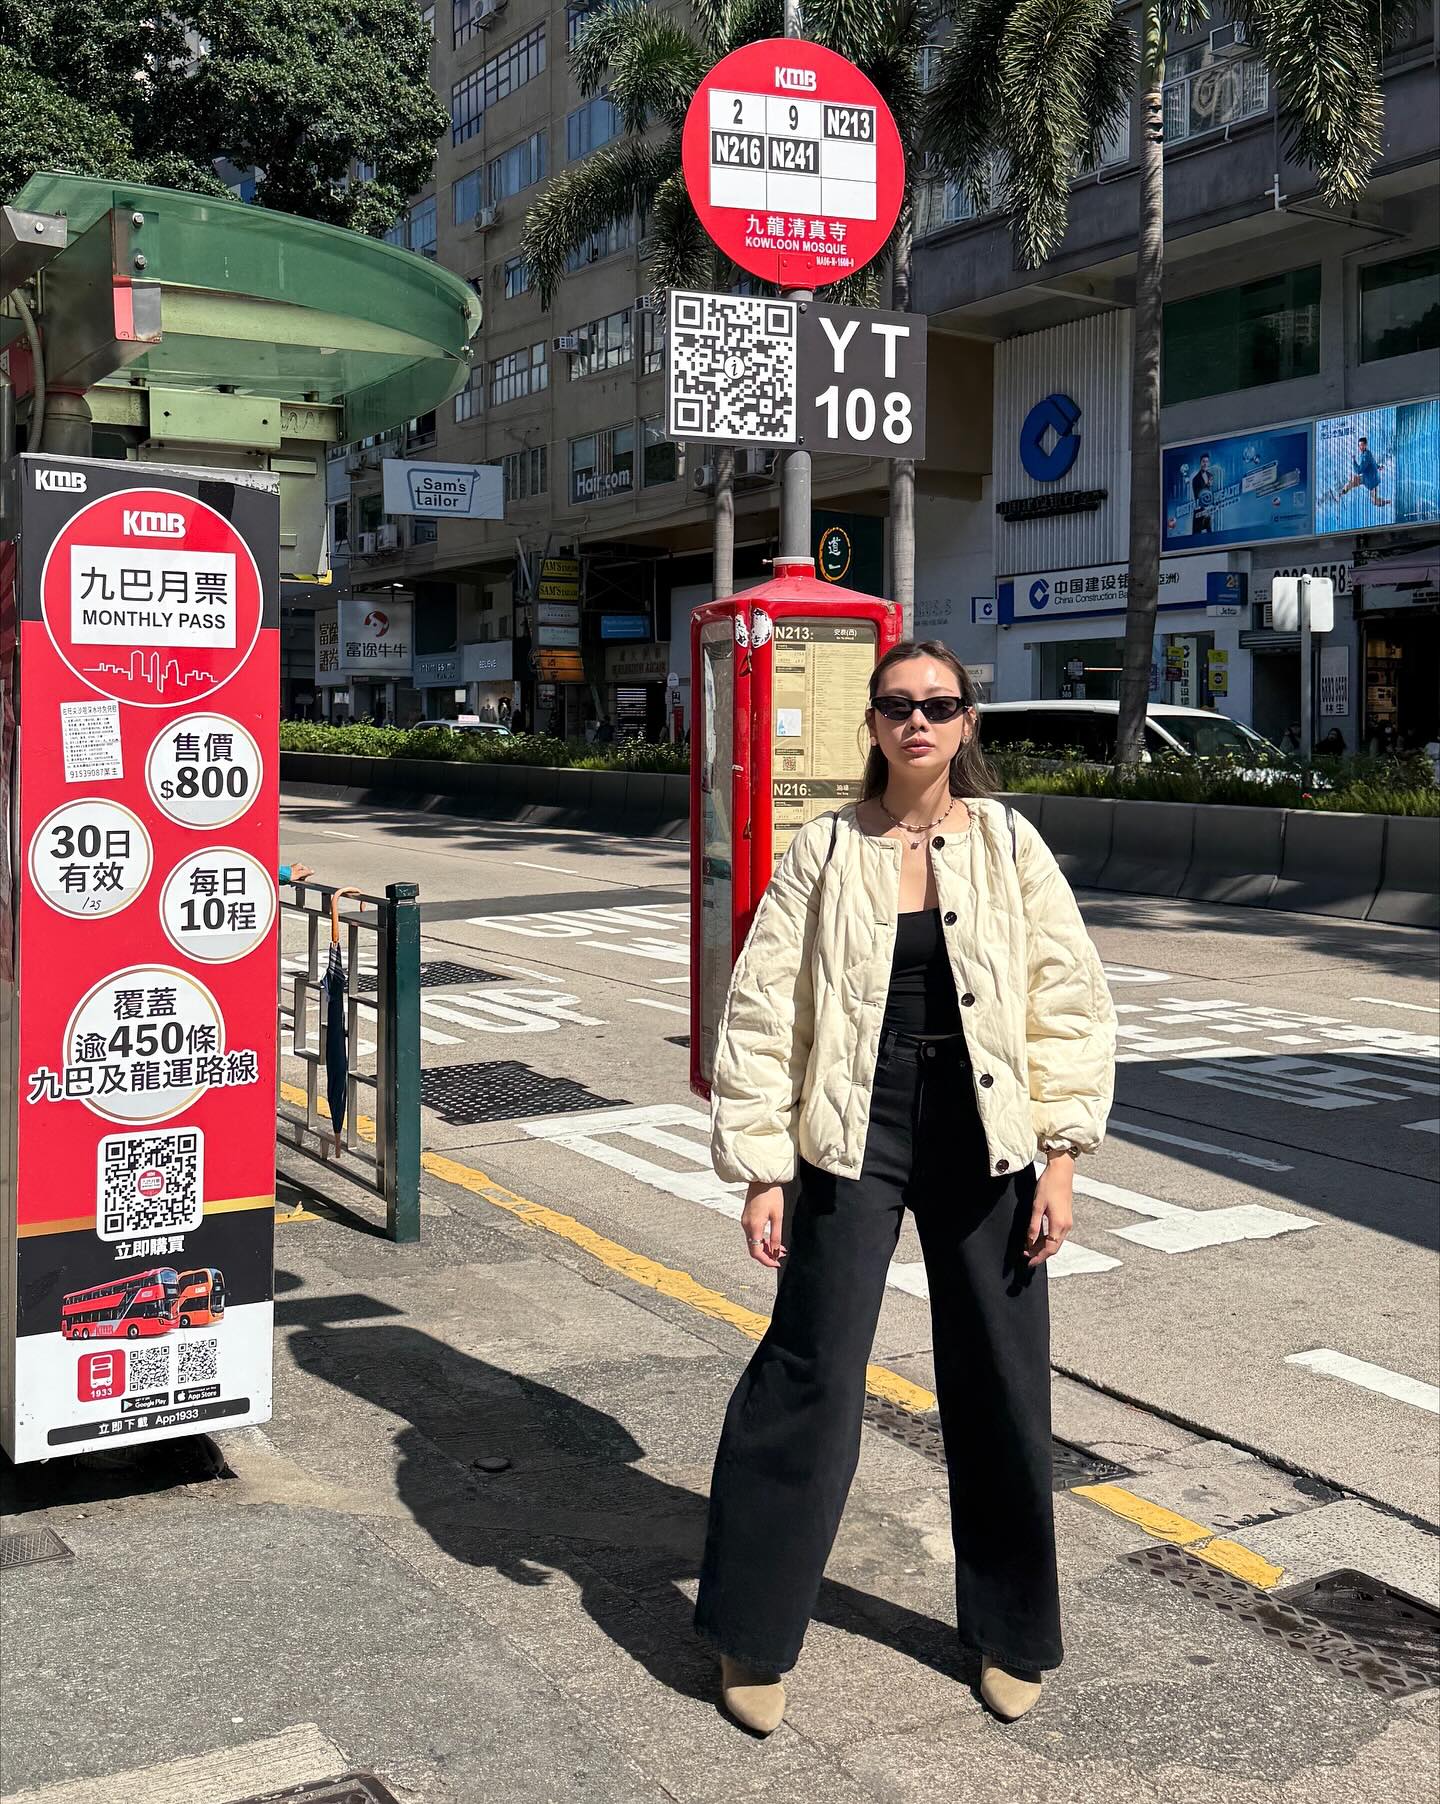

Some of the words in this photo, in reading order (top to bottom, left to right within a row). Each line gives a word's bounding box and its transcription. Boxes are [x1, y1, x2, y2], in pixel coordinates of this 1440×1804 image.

[775, 66, 817, 91] KMB
[733, 98, 743, 125] 2
[788, 105, 799, 131] 9
[827, 108, 871, 139] N213
[716, 134, 761, 166] N216
[772, 140, 815, 171] N241
[746, 213, 847, 242] 九龍清真寺
[745, 236, 800, 251] KOWLOON
[803, 241, 847, 255] MOSQUE
[815, 385, 913, 444] 108
[35, 469, 88, 493] KMB
[423, 477, 467, 492] Sam's
[415, 487, 459, 507] tailor
[123, 510, 186, 538] KMB
[80, 566, 228, 605] 九巴月票
[1054, 594, 1074, 605] China
[1076, 590, 1117, 603] Construction
[83, 609, 174, 628] MONTHLY
[179, 613, 226, 630] PASS
[774, 625, 814, 641] N213:
[345, 641, 408, 659] 富途牛牛
[172, 732, 234, 763] 售價
[160, 766, 249, 800] $800
[773, 783, 812, 797] N216:
[50, 824, 130, 859] 30日
[59, 861, 124, 893] 有效
[189, 866, 246, 896] 每日
[180, 898, 257, 931] 10程
[113, 987, 177, 1021] 覆蓋
[75, 1021, 216, 1065] 逾450條
[30, 1052, 258, 1101] 九巴及龍運路線
[114, 1235, 185, 1261] 立即購買
[90, 1388, 113, 1398] 1933
[188, 1392, 201, 1401] App
[201, 1389, 217, 1399] Store
[98, 1416, 149, 1435] 立即下載
[155, 1408, 199, 1426] App1933
